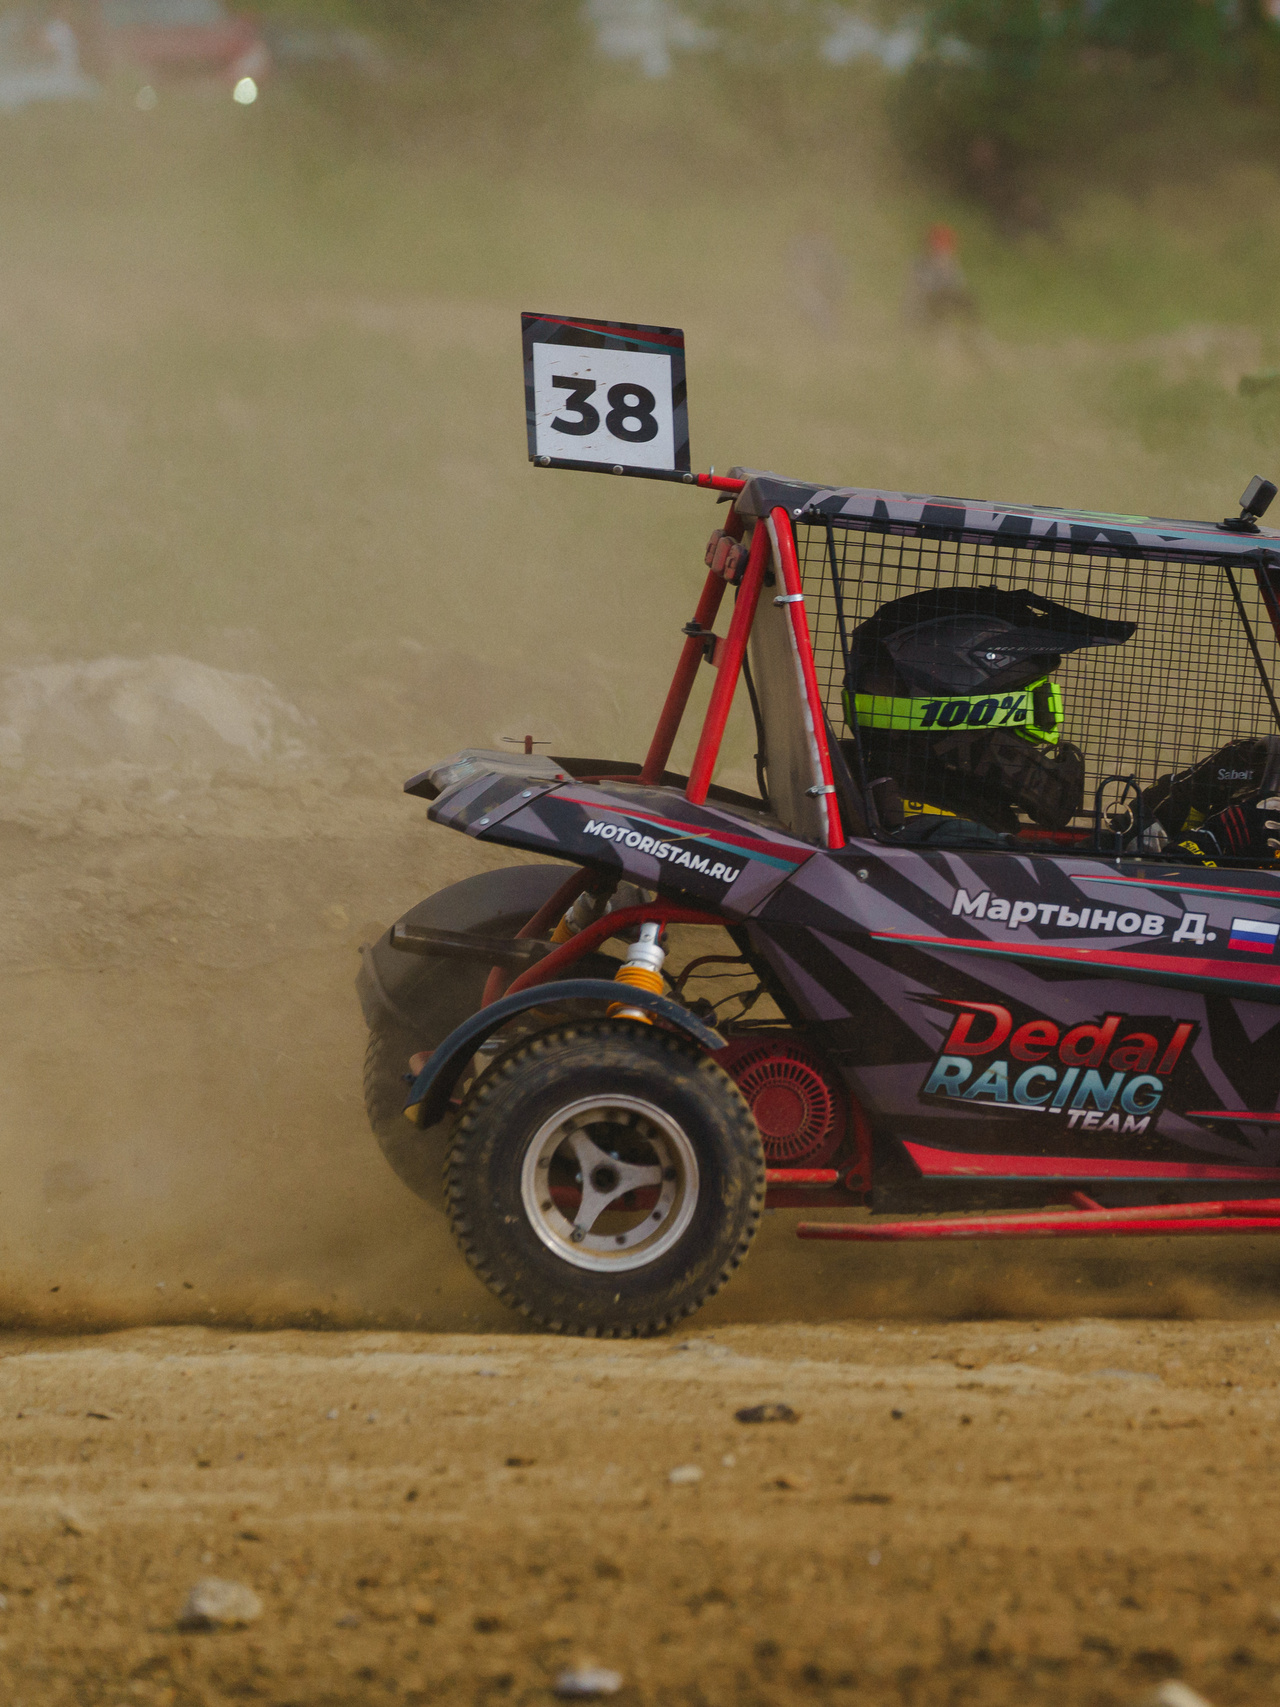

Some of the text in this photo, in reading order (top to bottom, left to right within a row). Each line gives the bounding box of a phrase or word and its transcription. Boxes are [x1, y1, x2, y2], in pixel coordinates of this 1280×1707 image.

[550, 374, 659, 443] 38
[919, 695, 1027, 729] 100%
[1217, 768, 1254, 780] Sabelt
[582, 818, 741, 884] MOTORISTAM.RU
[951, 888, 1218, 945] Мартынов Д.
[937, 999, 1194, 1075] Dedal
[923, 1054, 1165, 1115] RACING
[1065, 1108, 1152, 1135] TEAM
